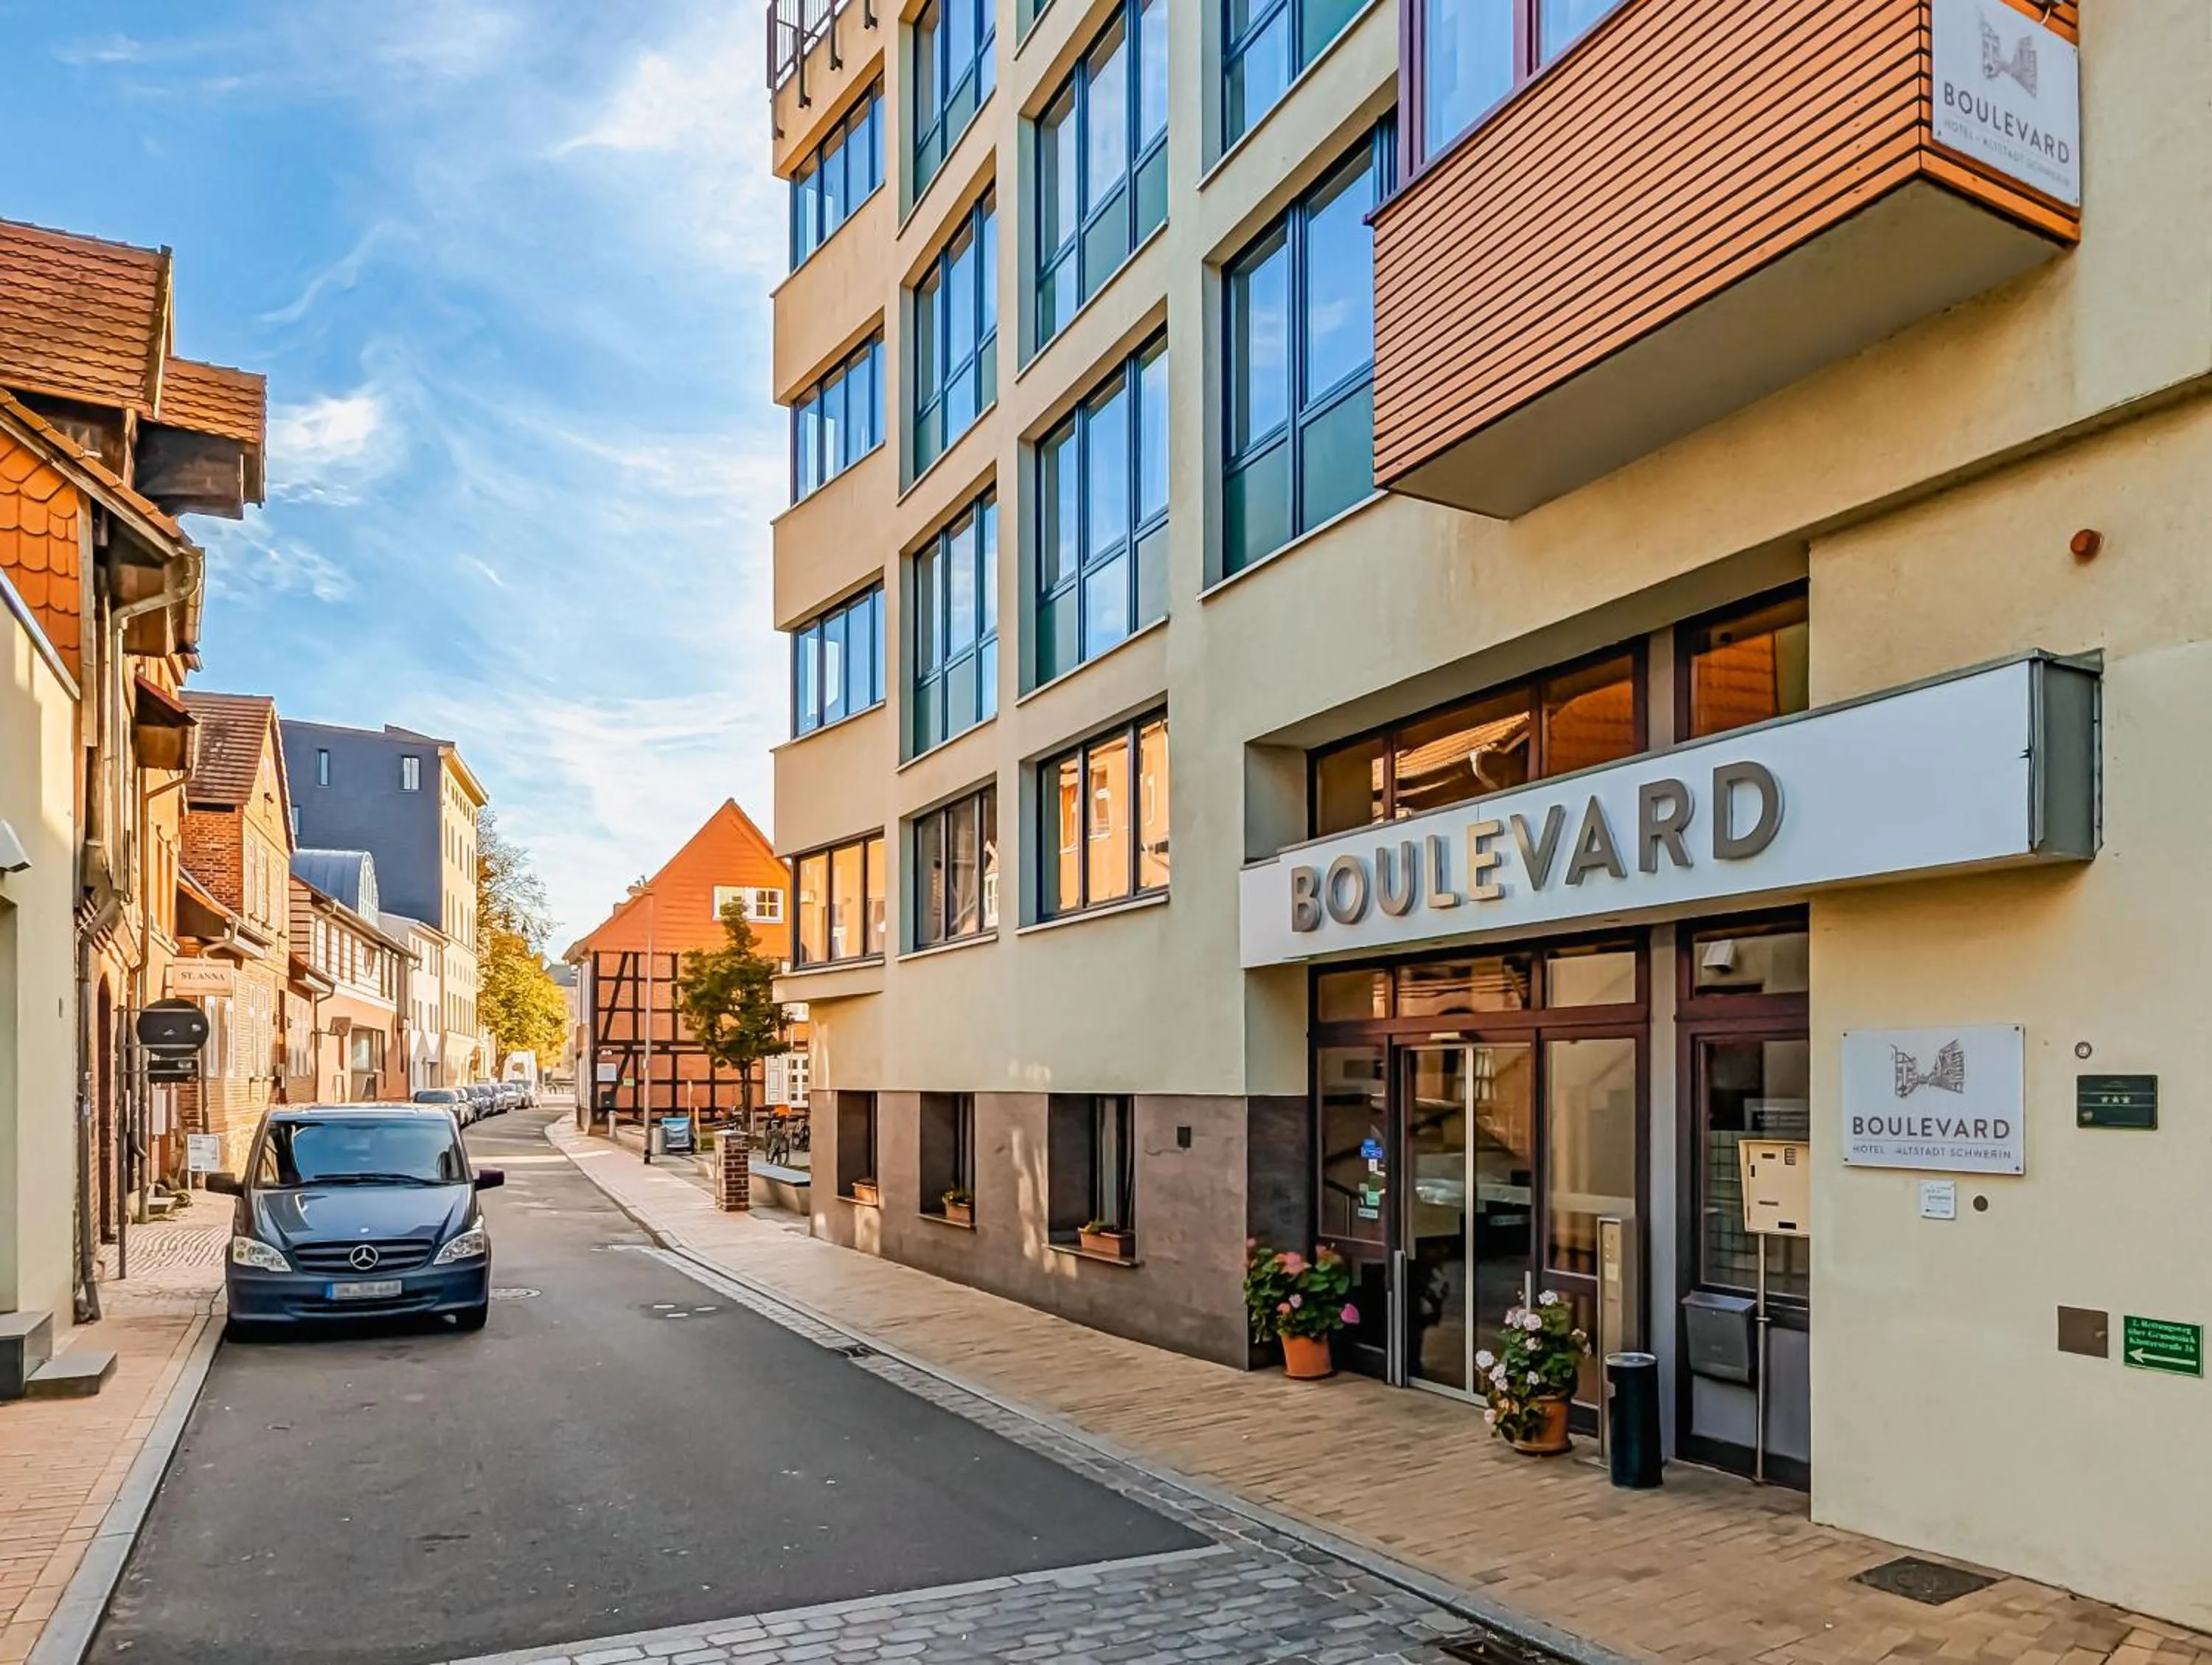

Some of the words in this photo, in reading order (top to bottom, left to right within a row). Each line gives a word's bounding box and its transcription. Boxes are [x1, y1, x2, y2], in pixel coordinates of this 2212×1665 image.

[1944, 82, 2070, 164] BOULEVARD
[1291, 760, 1784, 933] BOULEVARD
[198, 973, 225, 981] ANNA
[1852, 1116, 2011, 1139] BOULEVARD
[1853, 1145, 1885, 1155] HOTEL
[1896, 1146, 1946, 1156] ALTSTADT
[1950, 1148, 2011, 1160] SCHWERIN
